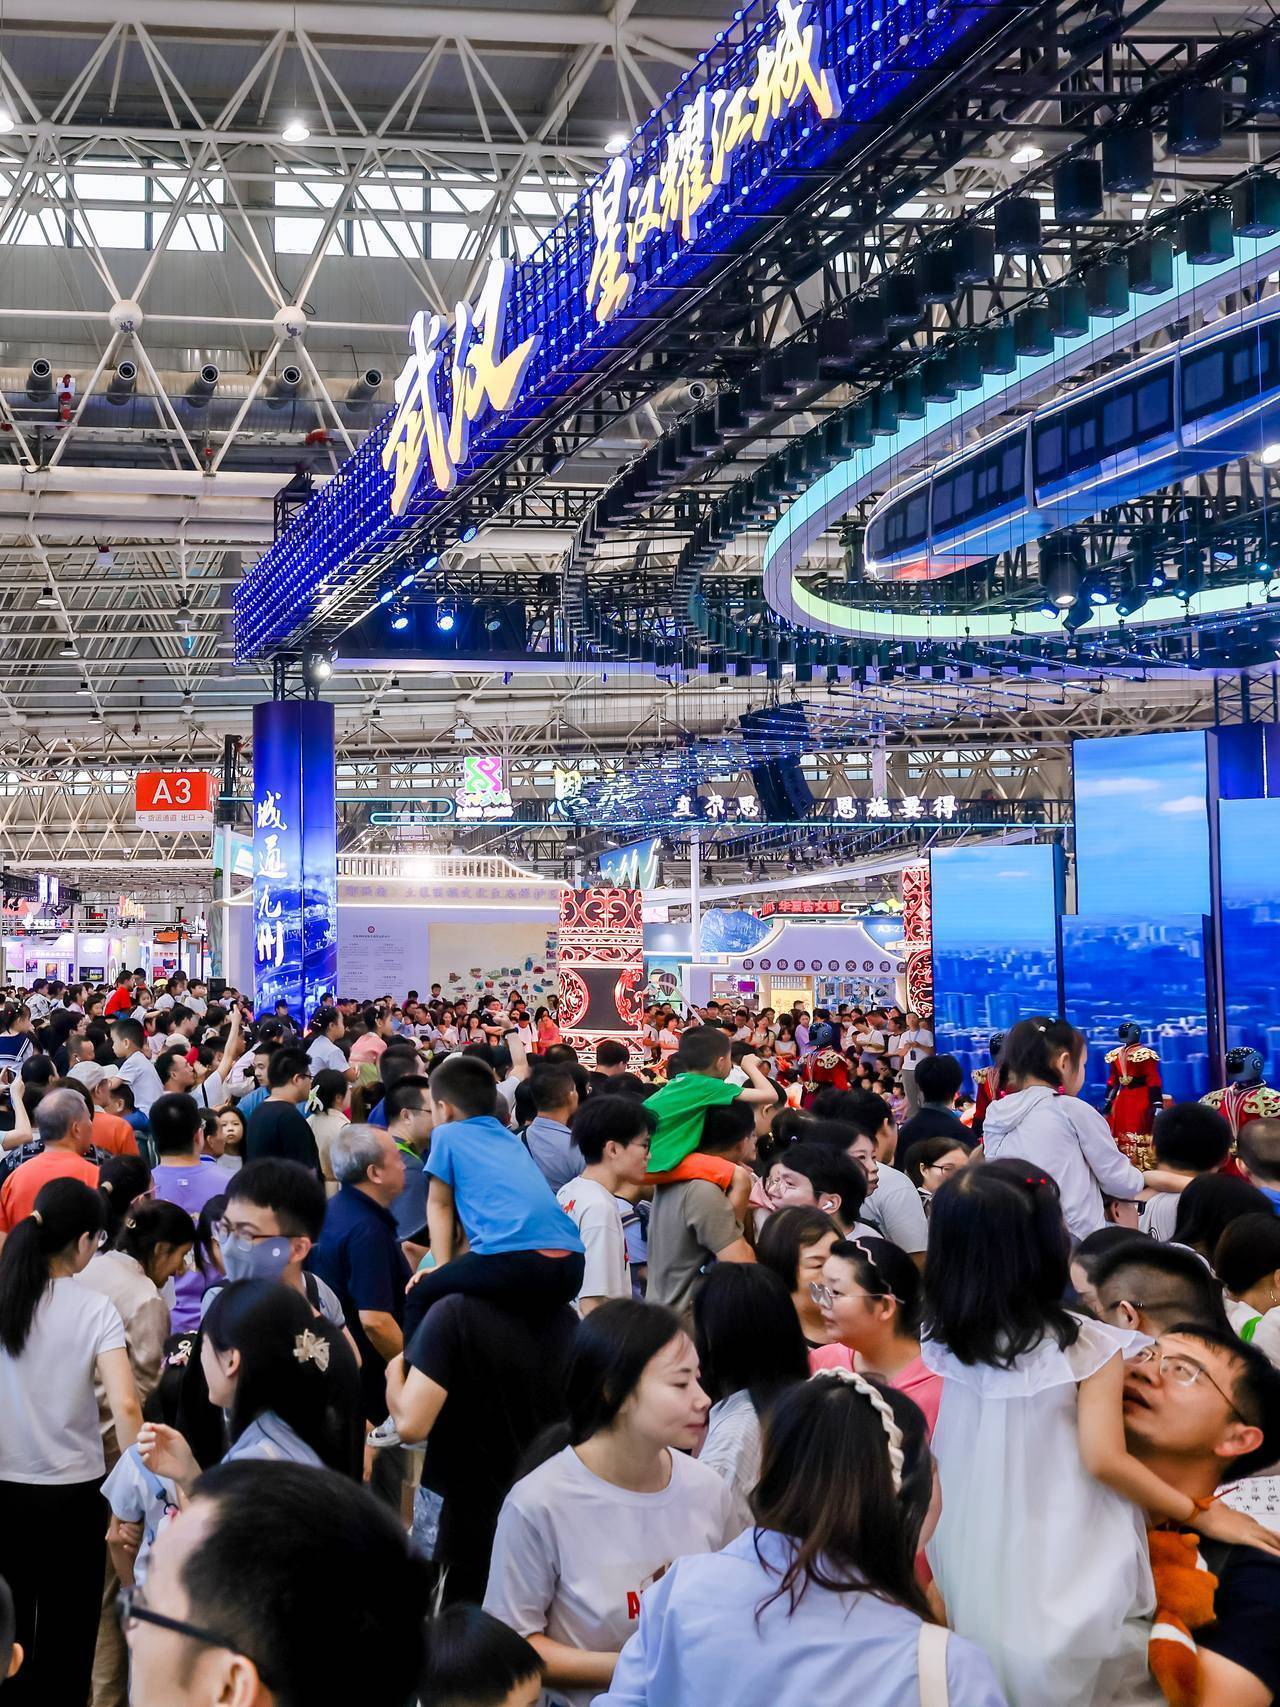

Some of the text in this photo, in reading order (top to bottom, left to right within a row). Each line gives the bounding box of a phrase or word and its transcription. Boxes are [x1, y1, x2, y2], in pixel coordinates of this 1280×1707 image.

[381, 258, 542, 517] 武汉
[152, 778, 191, 804] A3
[833, 795, 959, 819] 恩施要得
[257, 791, 288, 967] 城通九州
[778, 900, 840, 913] 华夏古文明
[744, 959, 906, 972] 国家级非物质文化遗产
